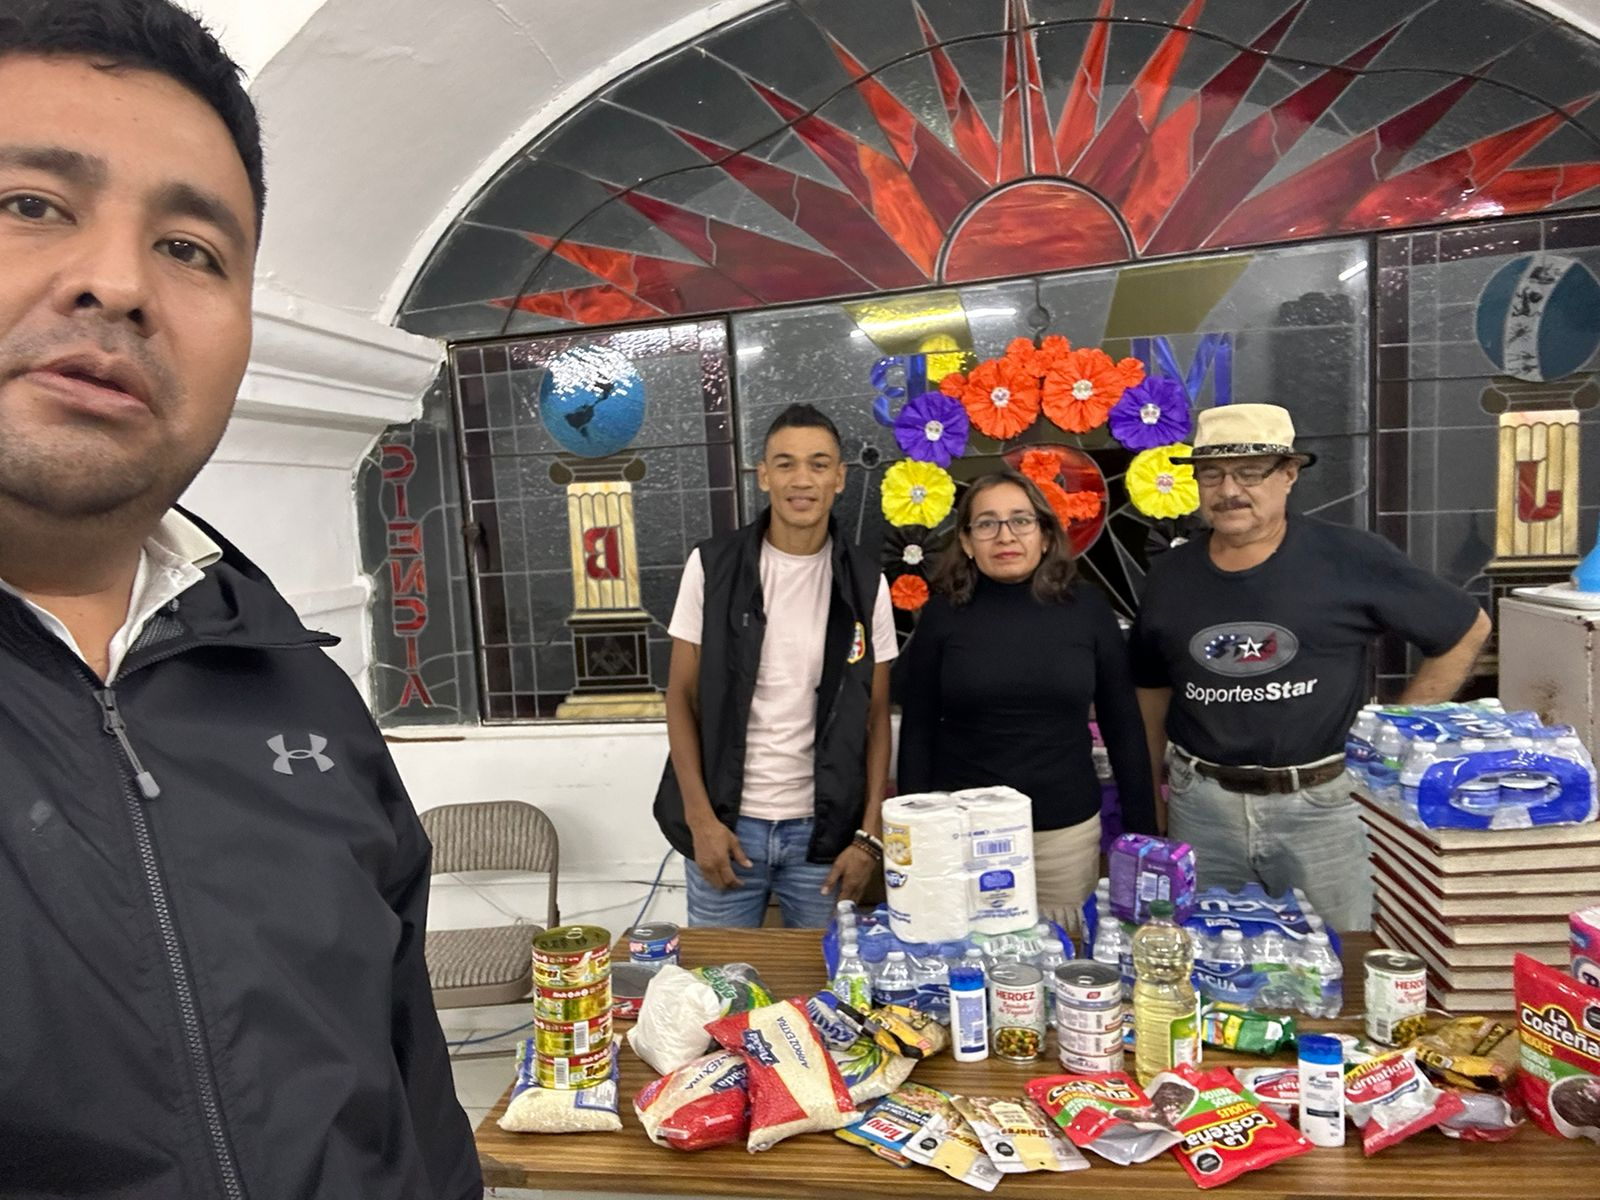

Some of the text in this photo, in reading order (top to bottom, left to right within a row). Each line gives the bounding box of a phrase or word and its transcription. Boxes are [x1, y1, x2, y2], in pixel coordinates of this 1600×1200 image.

[1185, 678, 1318, 706] SoportesStar
[1550, 1008, 1568, 1027] La
[776, 1015, 810, 1069] ARROZ EXTRA
[1521, 1007, 1600, 1057] Costeña
[865, 1116, 903, 1143] Tuny
[1185, 1113, 1269, 1147] Costeña
[1223, 1132, 1246, 1147] La
